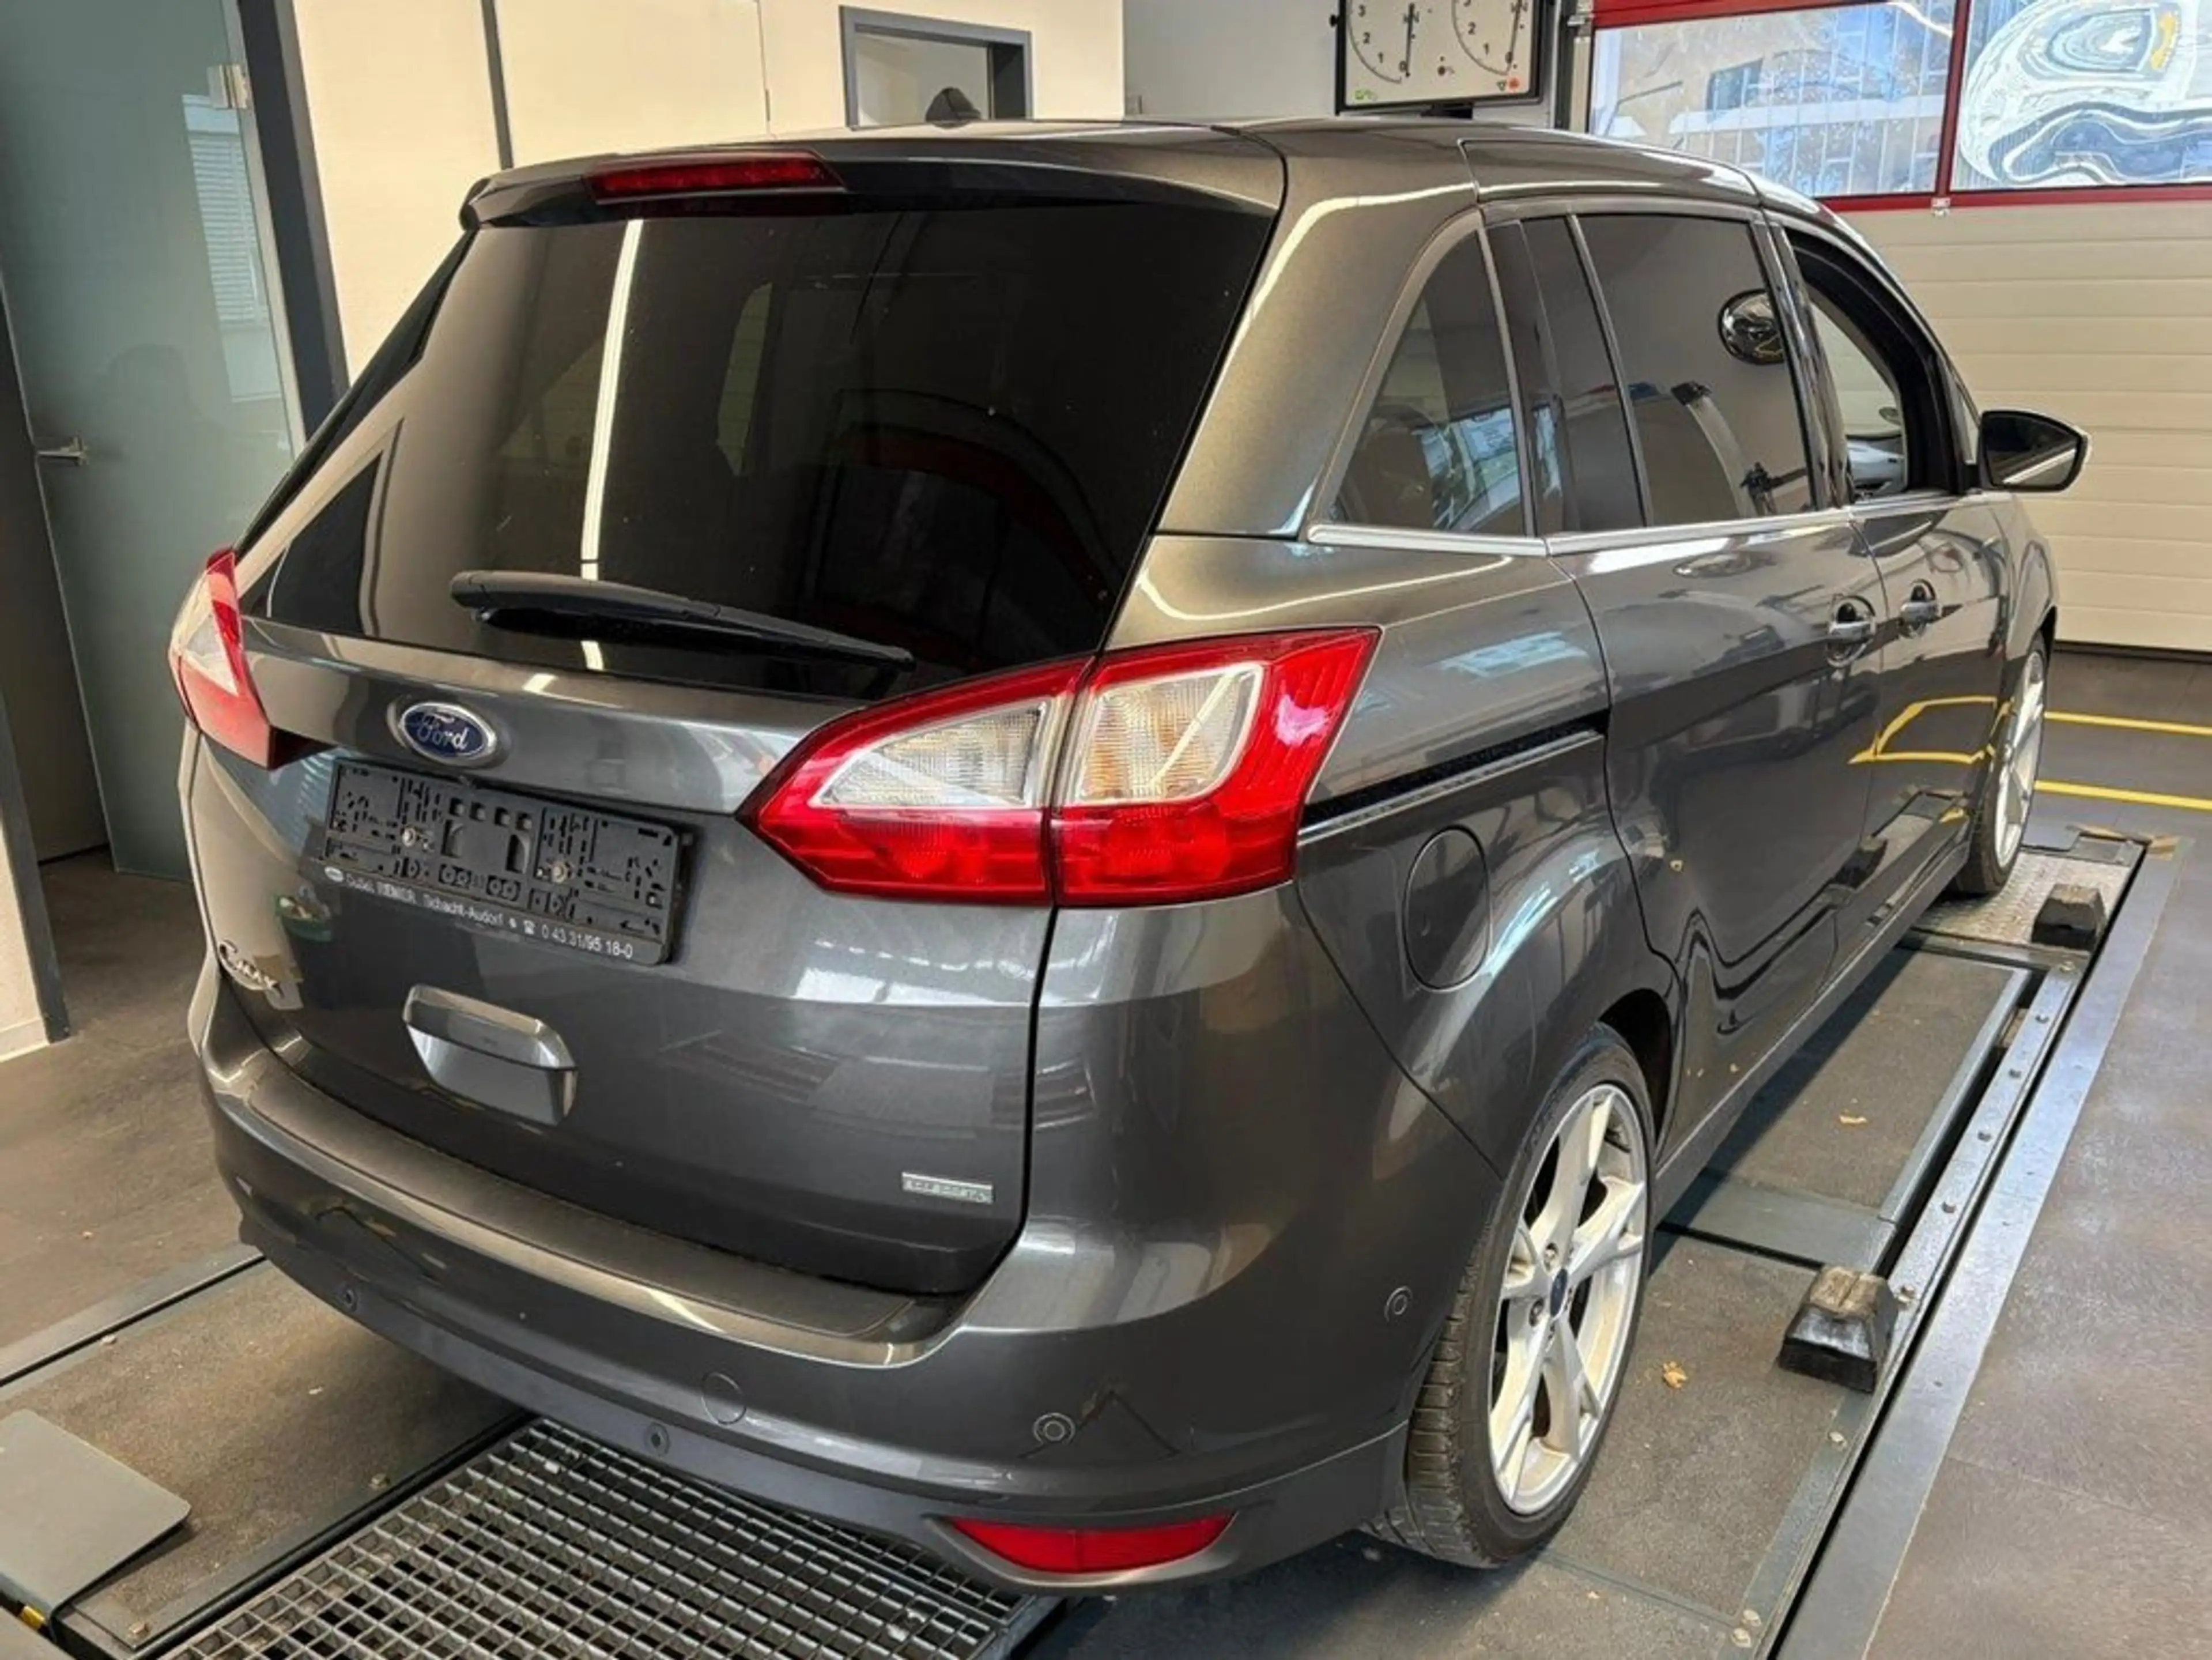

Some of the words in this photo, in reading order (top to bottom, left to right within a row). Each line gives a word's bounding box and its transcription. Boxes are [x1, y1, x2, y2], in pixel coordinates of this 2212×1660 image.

[1358, 4, 1366, 17] 3
[1468, 21, 1476, 35] 2
[1363, 32, 1371, 44] 2
[1483, 43, 1489, 56] 1
[1378, 51, 1384, 63] 1
[1399, 61, 1407, 73] 0
[413, 712, 470, 750] Ford
[541, 924, 549, 939] 0
[606, 940, 633, 960] 18-0
